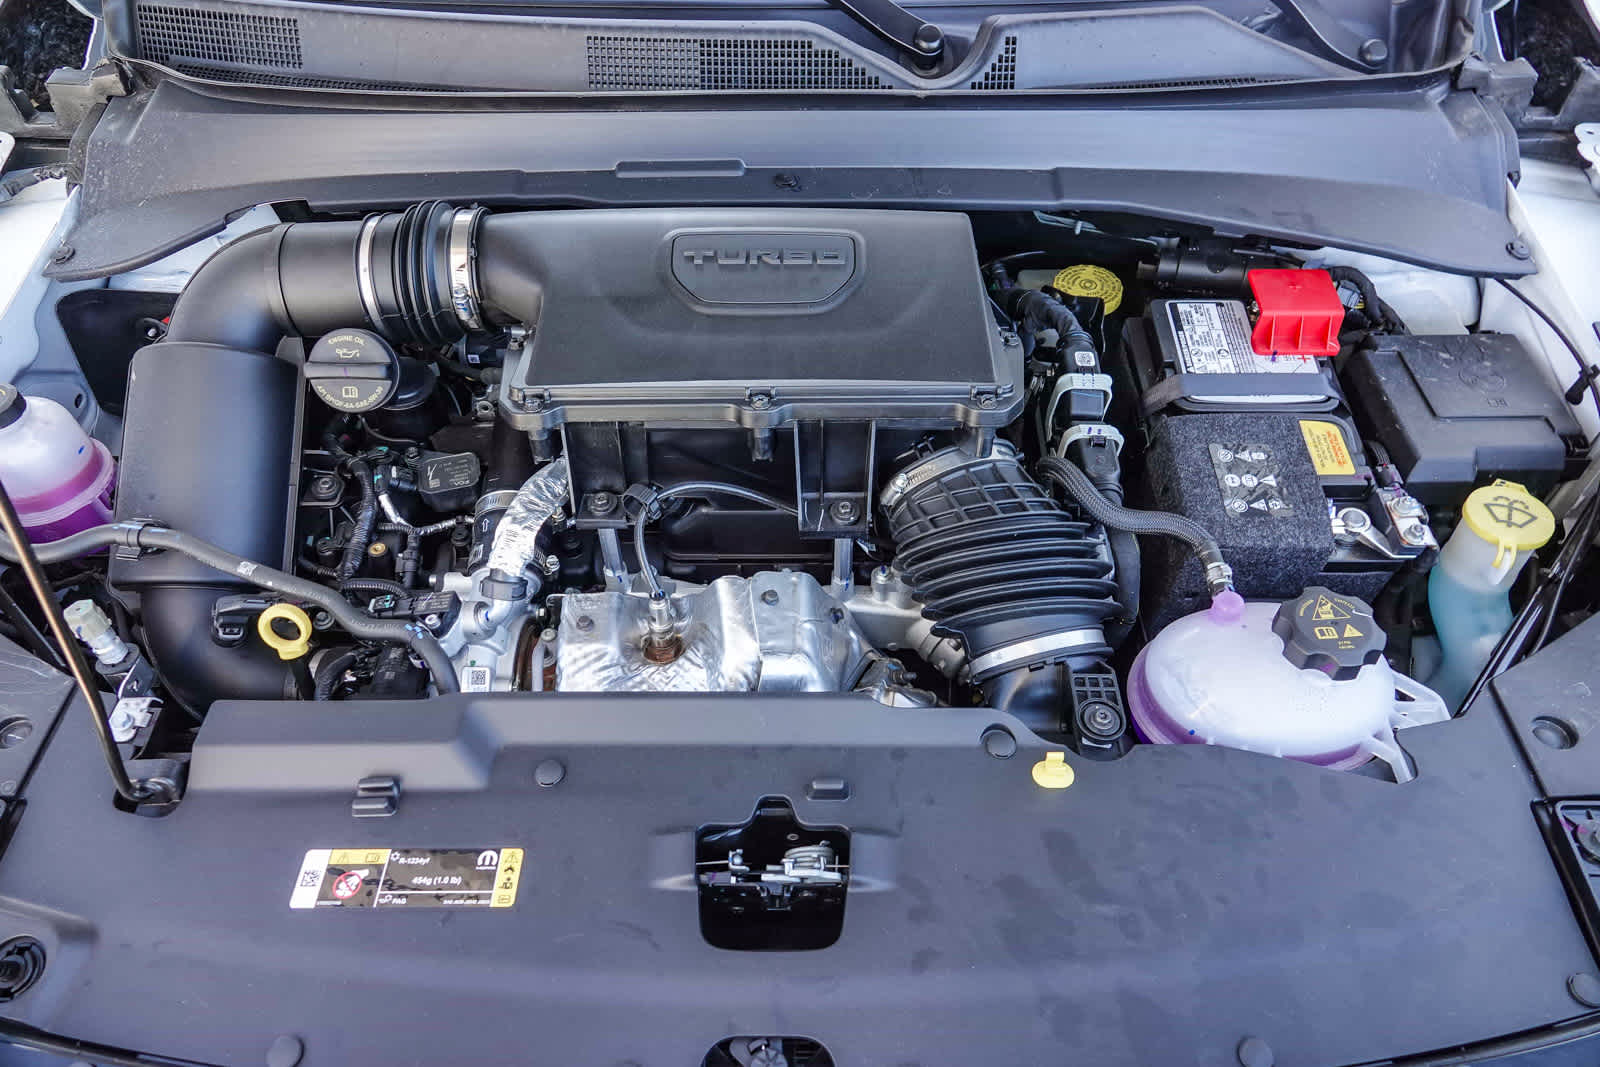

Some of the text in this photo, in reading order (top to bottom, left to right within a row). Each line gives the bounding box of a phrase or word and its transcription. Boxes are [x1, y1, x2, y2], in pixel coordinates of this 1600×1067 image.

[683, 250, 845, 265] TURBO
[327, 335, 353, 345] ENGINE
[412, 876, 432, 886] 454g
